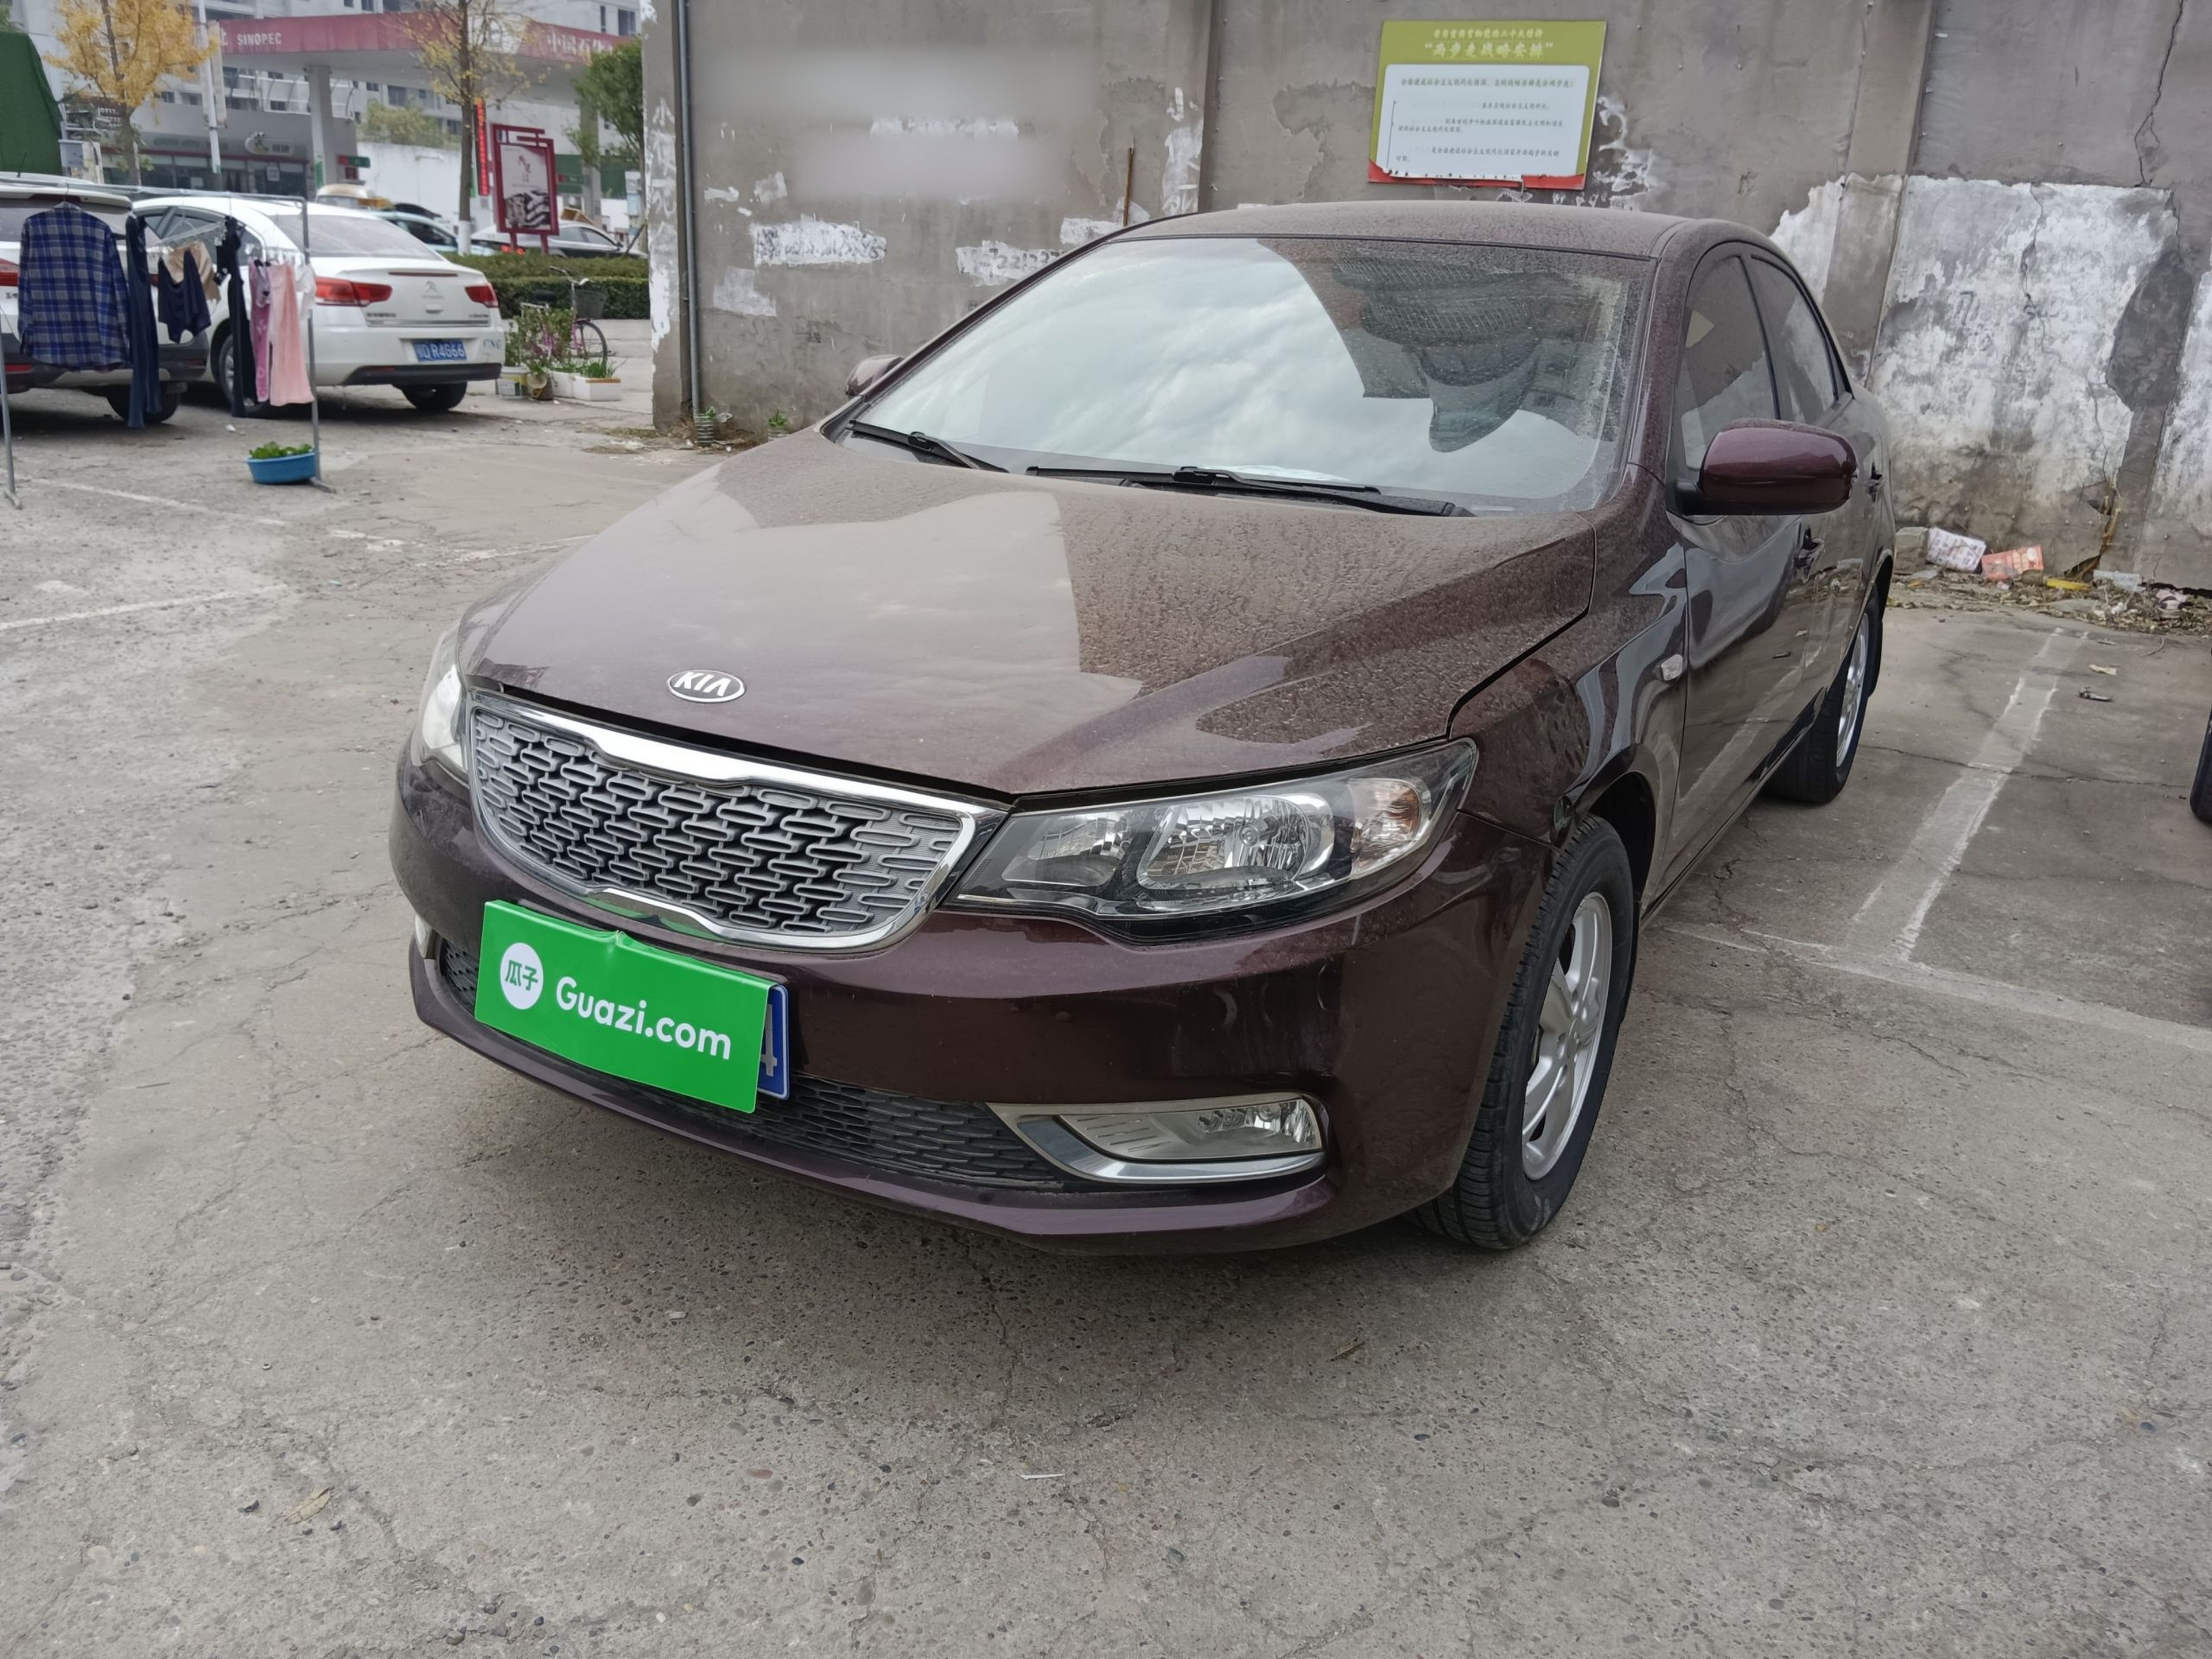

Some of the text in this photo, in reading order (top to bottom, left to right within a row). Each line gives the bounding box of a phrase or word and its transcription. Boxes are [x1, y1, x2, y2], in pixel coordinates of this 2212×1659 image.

[237, 32, 282, 46] SINOPEC
[673, 672, 732, 697] KIA
[505, 960, 538, 991] 瓜子
[556, 976, 732, 1060] Guazi.com
